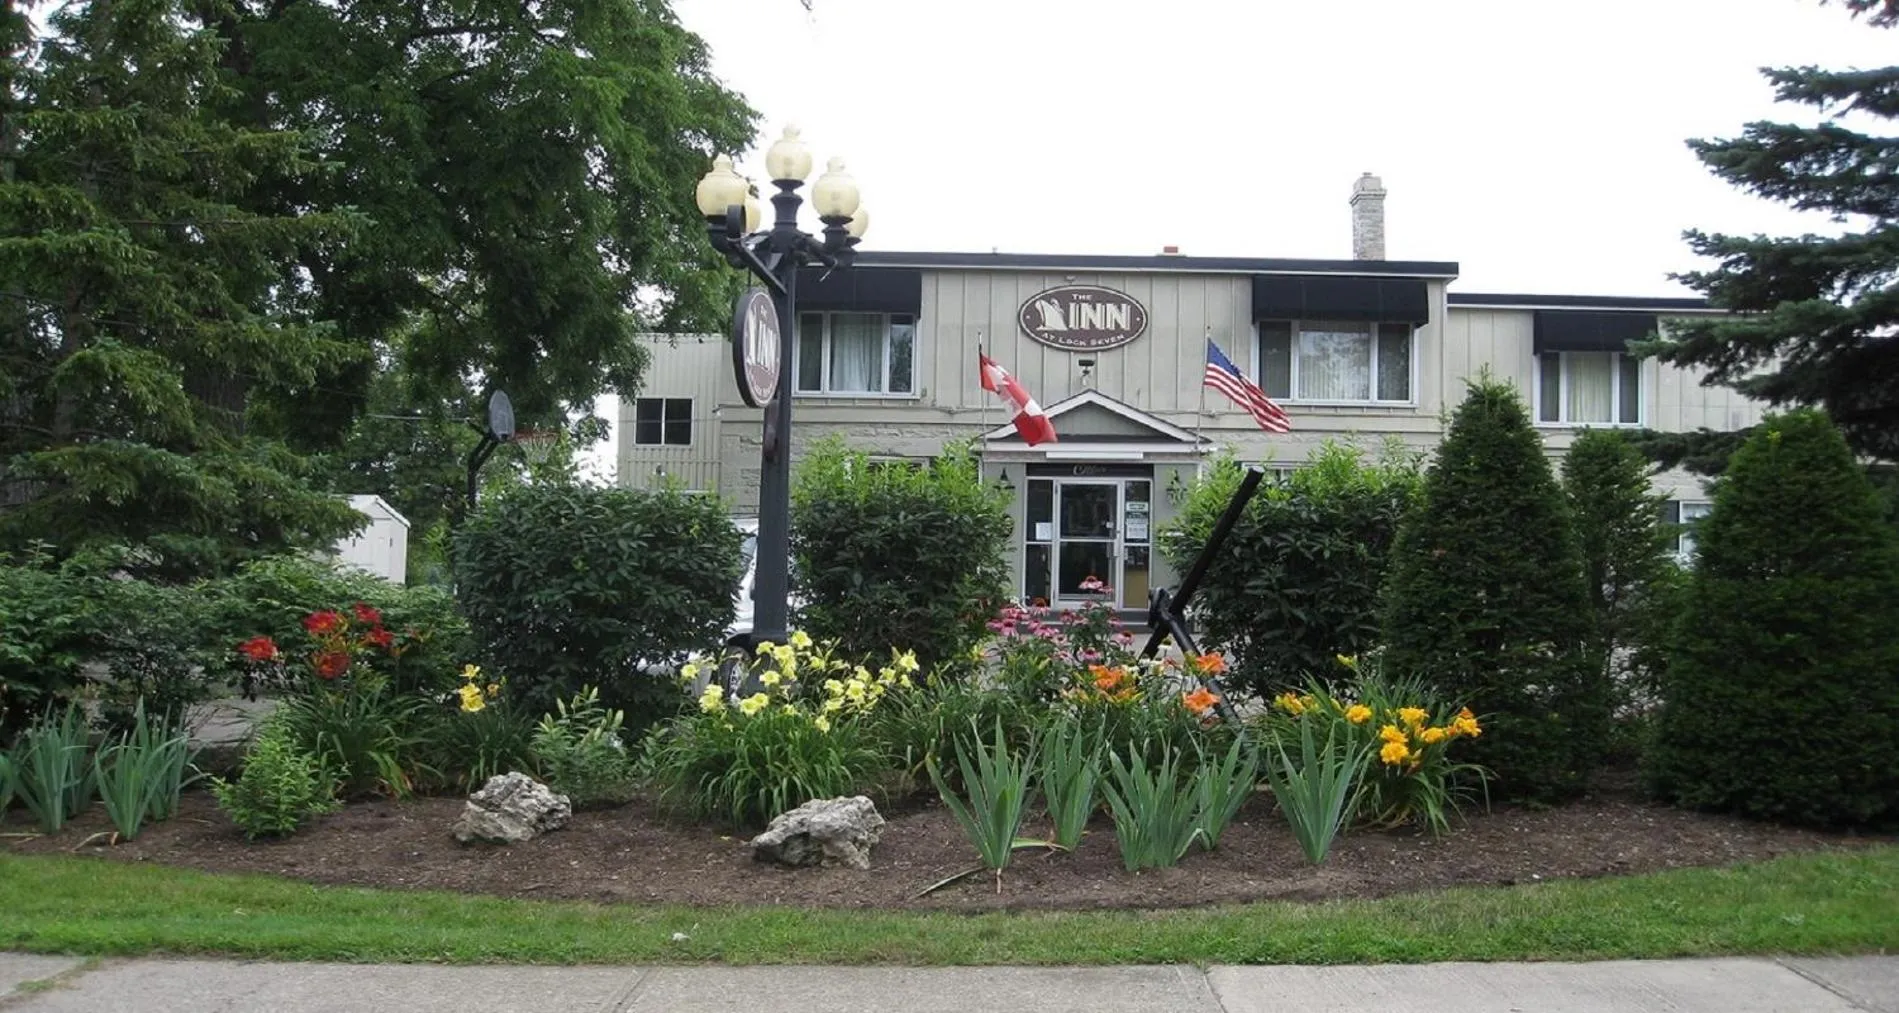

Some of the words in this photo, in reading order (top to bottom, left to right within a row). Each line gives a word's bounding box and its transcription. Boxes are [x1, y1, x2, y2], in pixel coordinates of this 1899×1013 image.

[1069, 303, 1131, 330] INN
[1041, 332, 1056, 341] AT
[1058, 336, 1087, 347] LOCK
[1090, 333, 1125, 346] SEVEN
